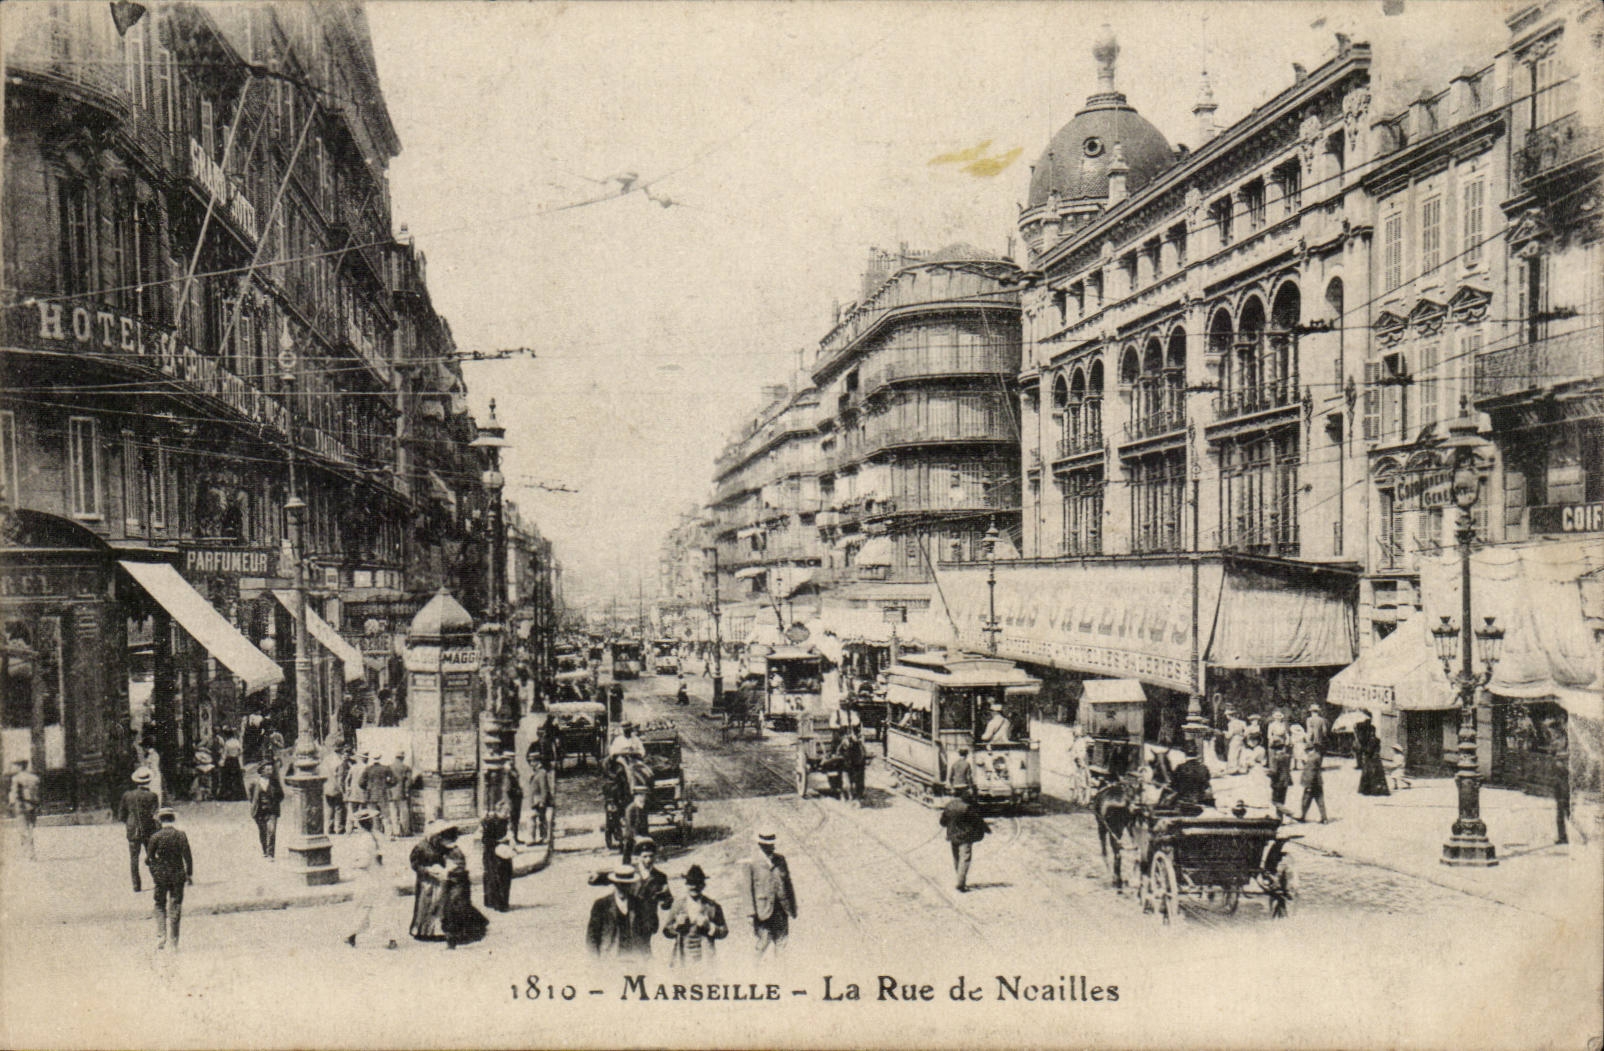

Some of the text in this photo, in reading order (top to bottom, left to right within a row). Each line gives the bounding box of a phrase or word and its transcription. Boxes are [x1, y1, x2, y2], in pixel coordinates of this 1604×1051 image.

[39, 302, 145, 356] HOTEL
[1562, 505, 1602, 531] COIF
[187, 551, 267, 572] PARFUMEUR
